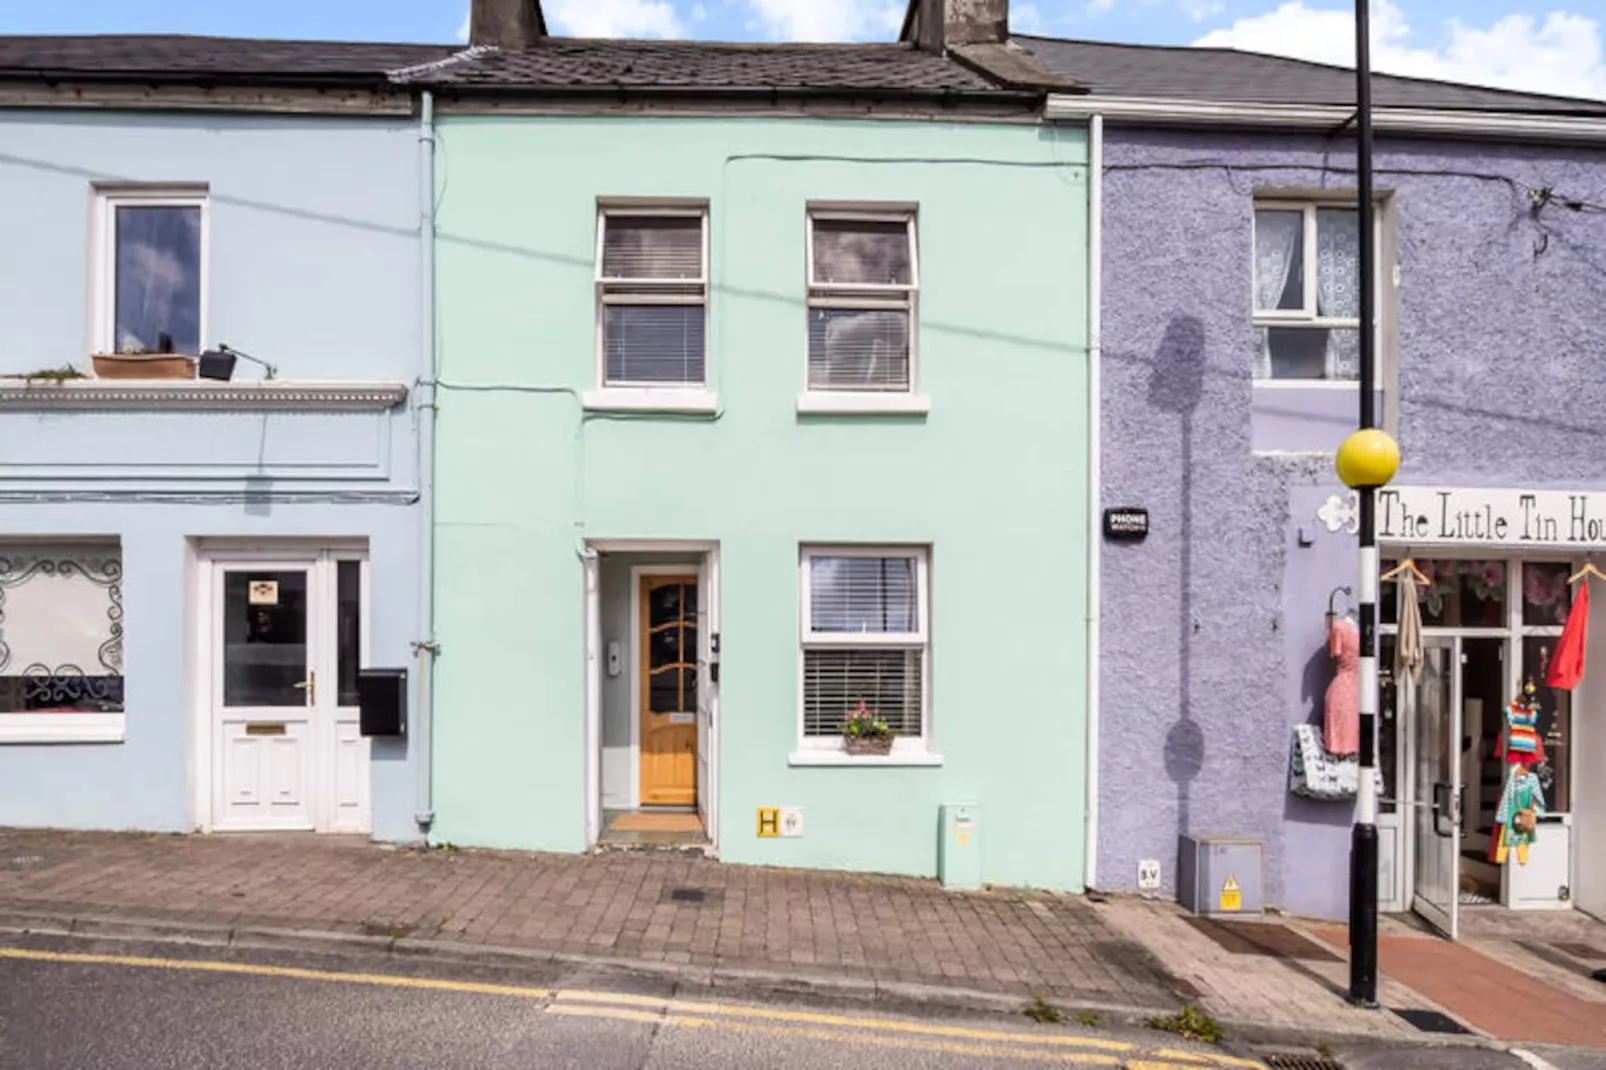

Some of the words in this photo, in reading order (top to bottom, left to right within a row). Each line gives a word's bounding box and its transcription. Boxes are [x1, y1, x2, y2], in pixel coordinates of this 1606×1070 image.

[1110, 513, 1147, 524] PHONE
[1378, 489, 1428, 538] The
[1436, 491, 1508, 540] Little
[1519, 494, 1557, 541] Tin
[760, 809, 777, 834] H
